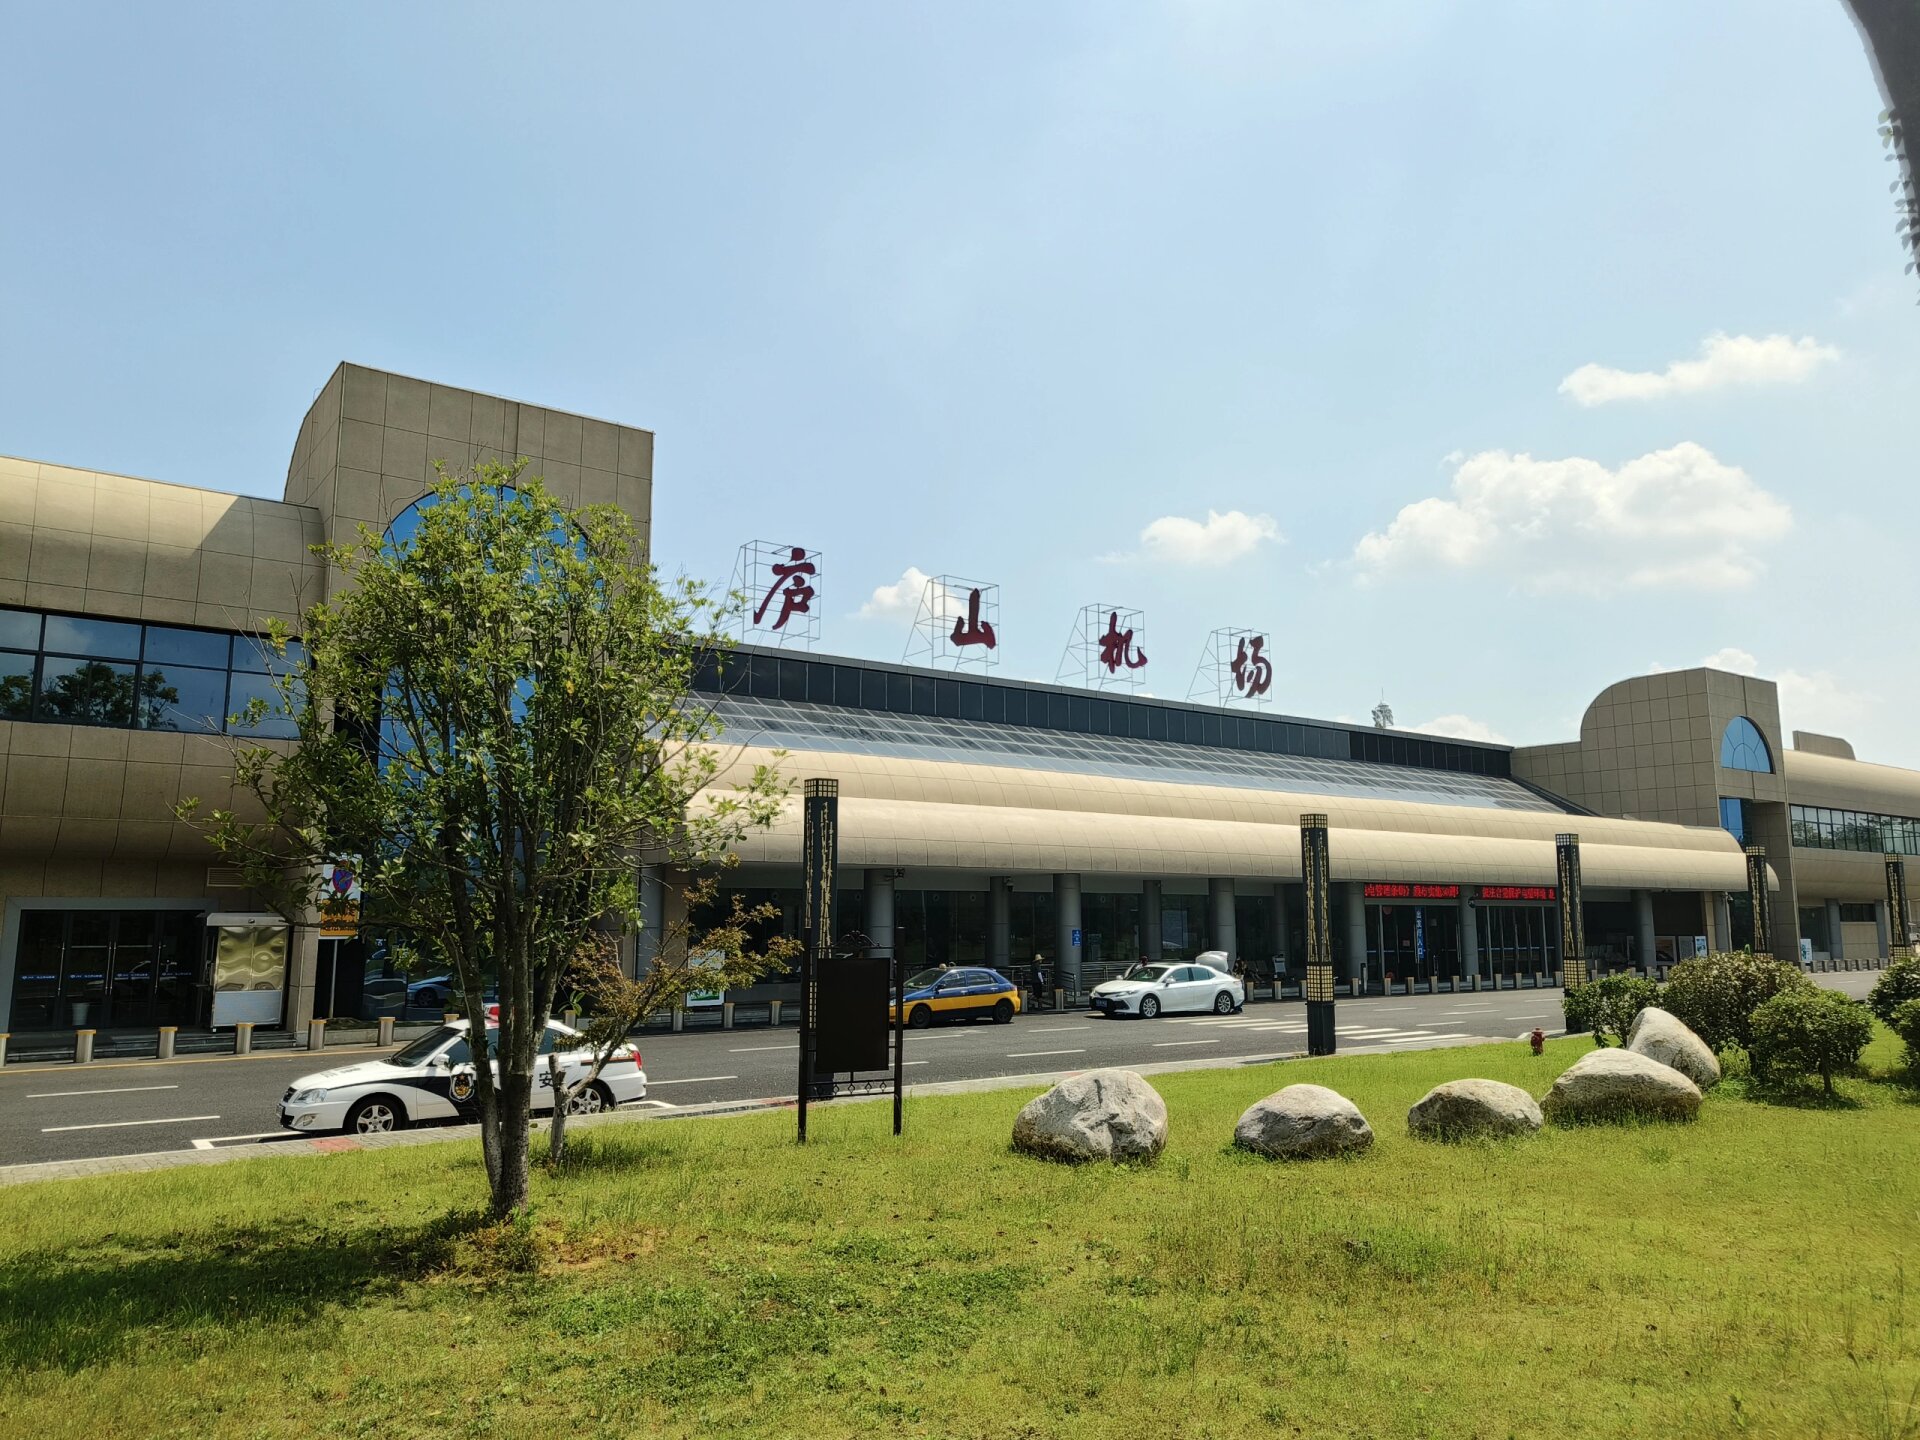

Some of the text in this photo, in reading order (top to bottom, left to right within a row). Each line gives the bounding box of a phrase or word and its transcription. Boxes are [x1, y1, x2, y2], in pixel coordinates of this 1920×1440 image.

[754, 548, 1273, 698] 庐山机场
[538, 1071, 554, 1088] 安
